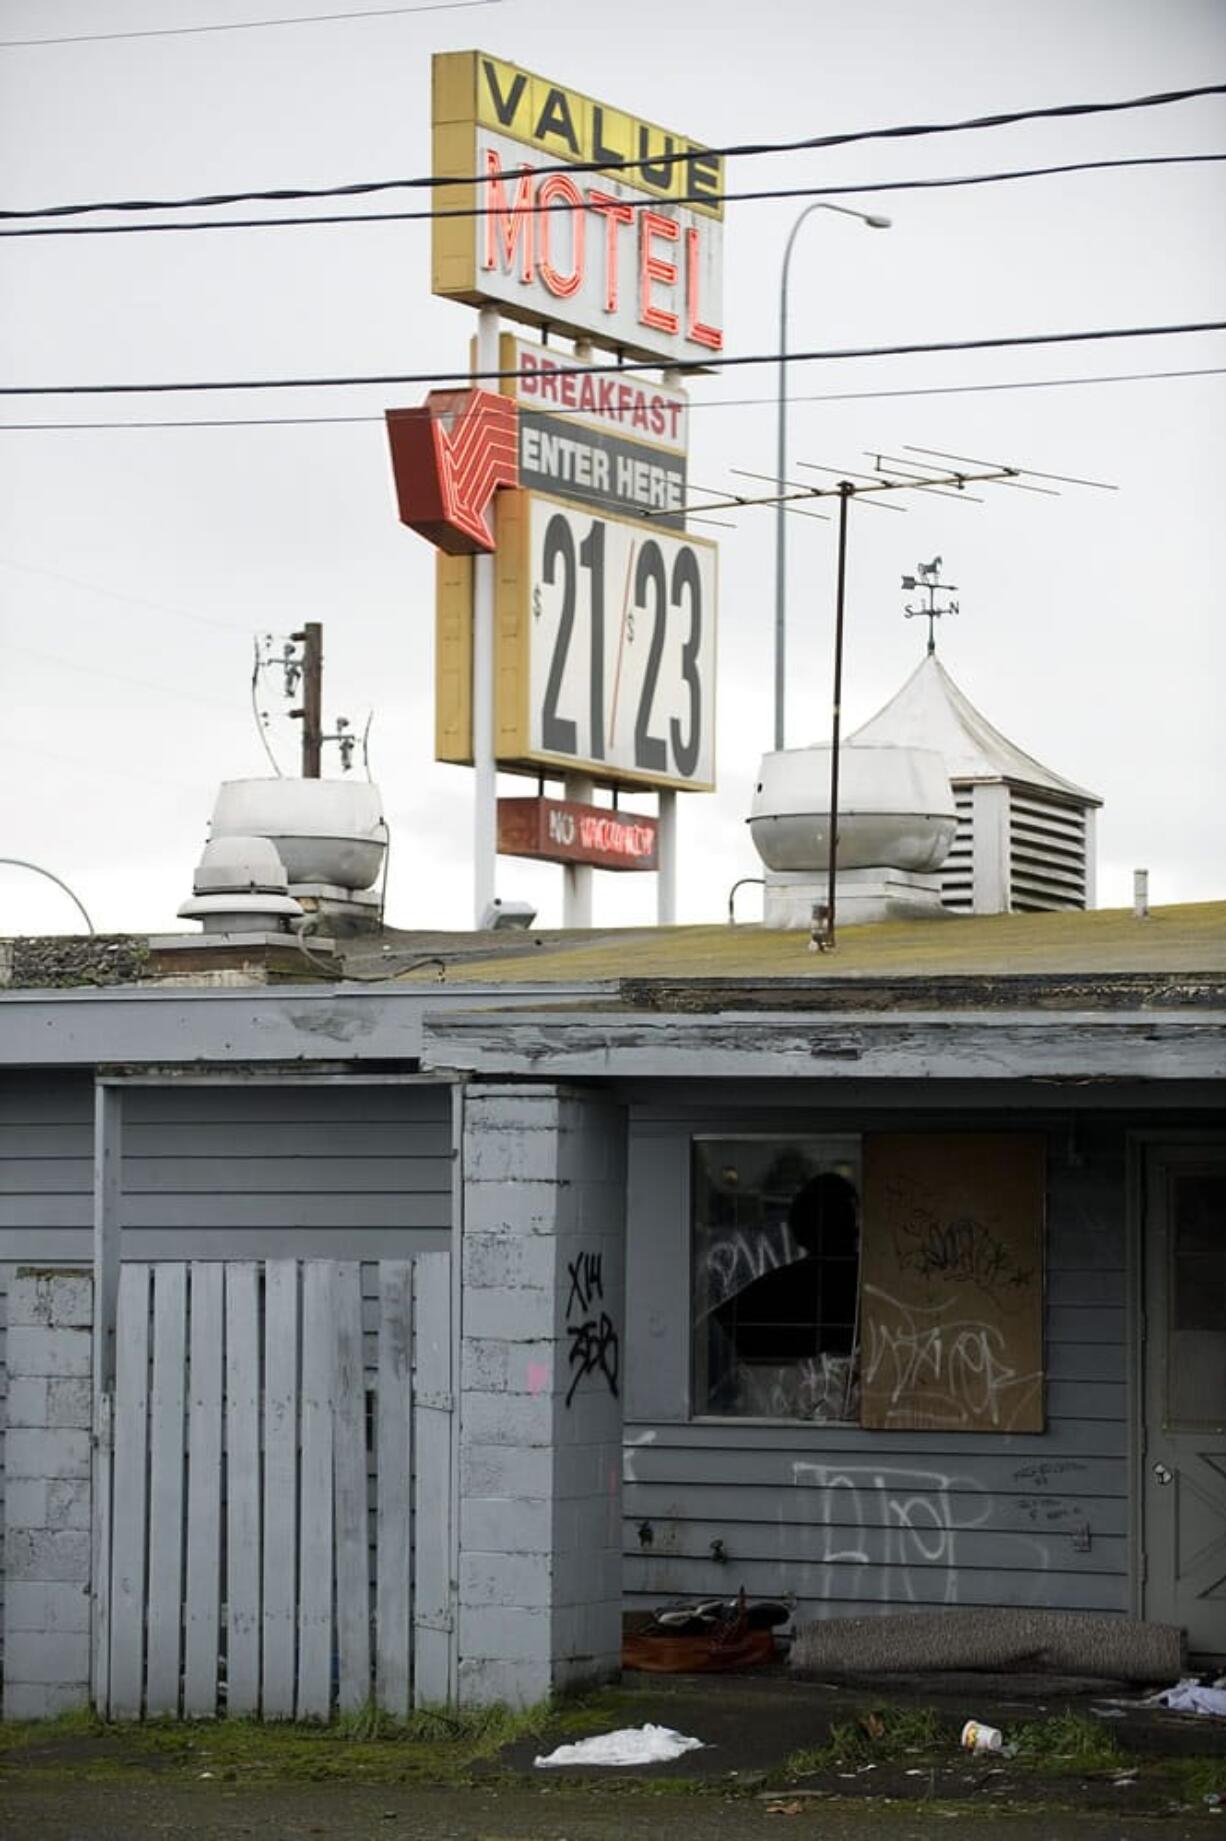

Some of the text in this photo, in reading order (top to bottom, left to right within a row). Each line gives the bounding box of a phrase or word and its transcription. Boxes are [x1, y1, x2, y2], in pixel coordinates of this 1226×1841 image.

[482, 59, 720, 208] VALUE
[484, 148, 723, 350] MOTEL
[520, 352, 682, 439] BREAKFAST
[521, 426, 683, 509] ENTER HERE
[549, 809, 575, 846] NO
